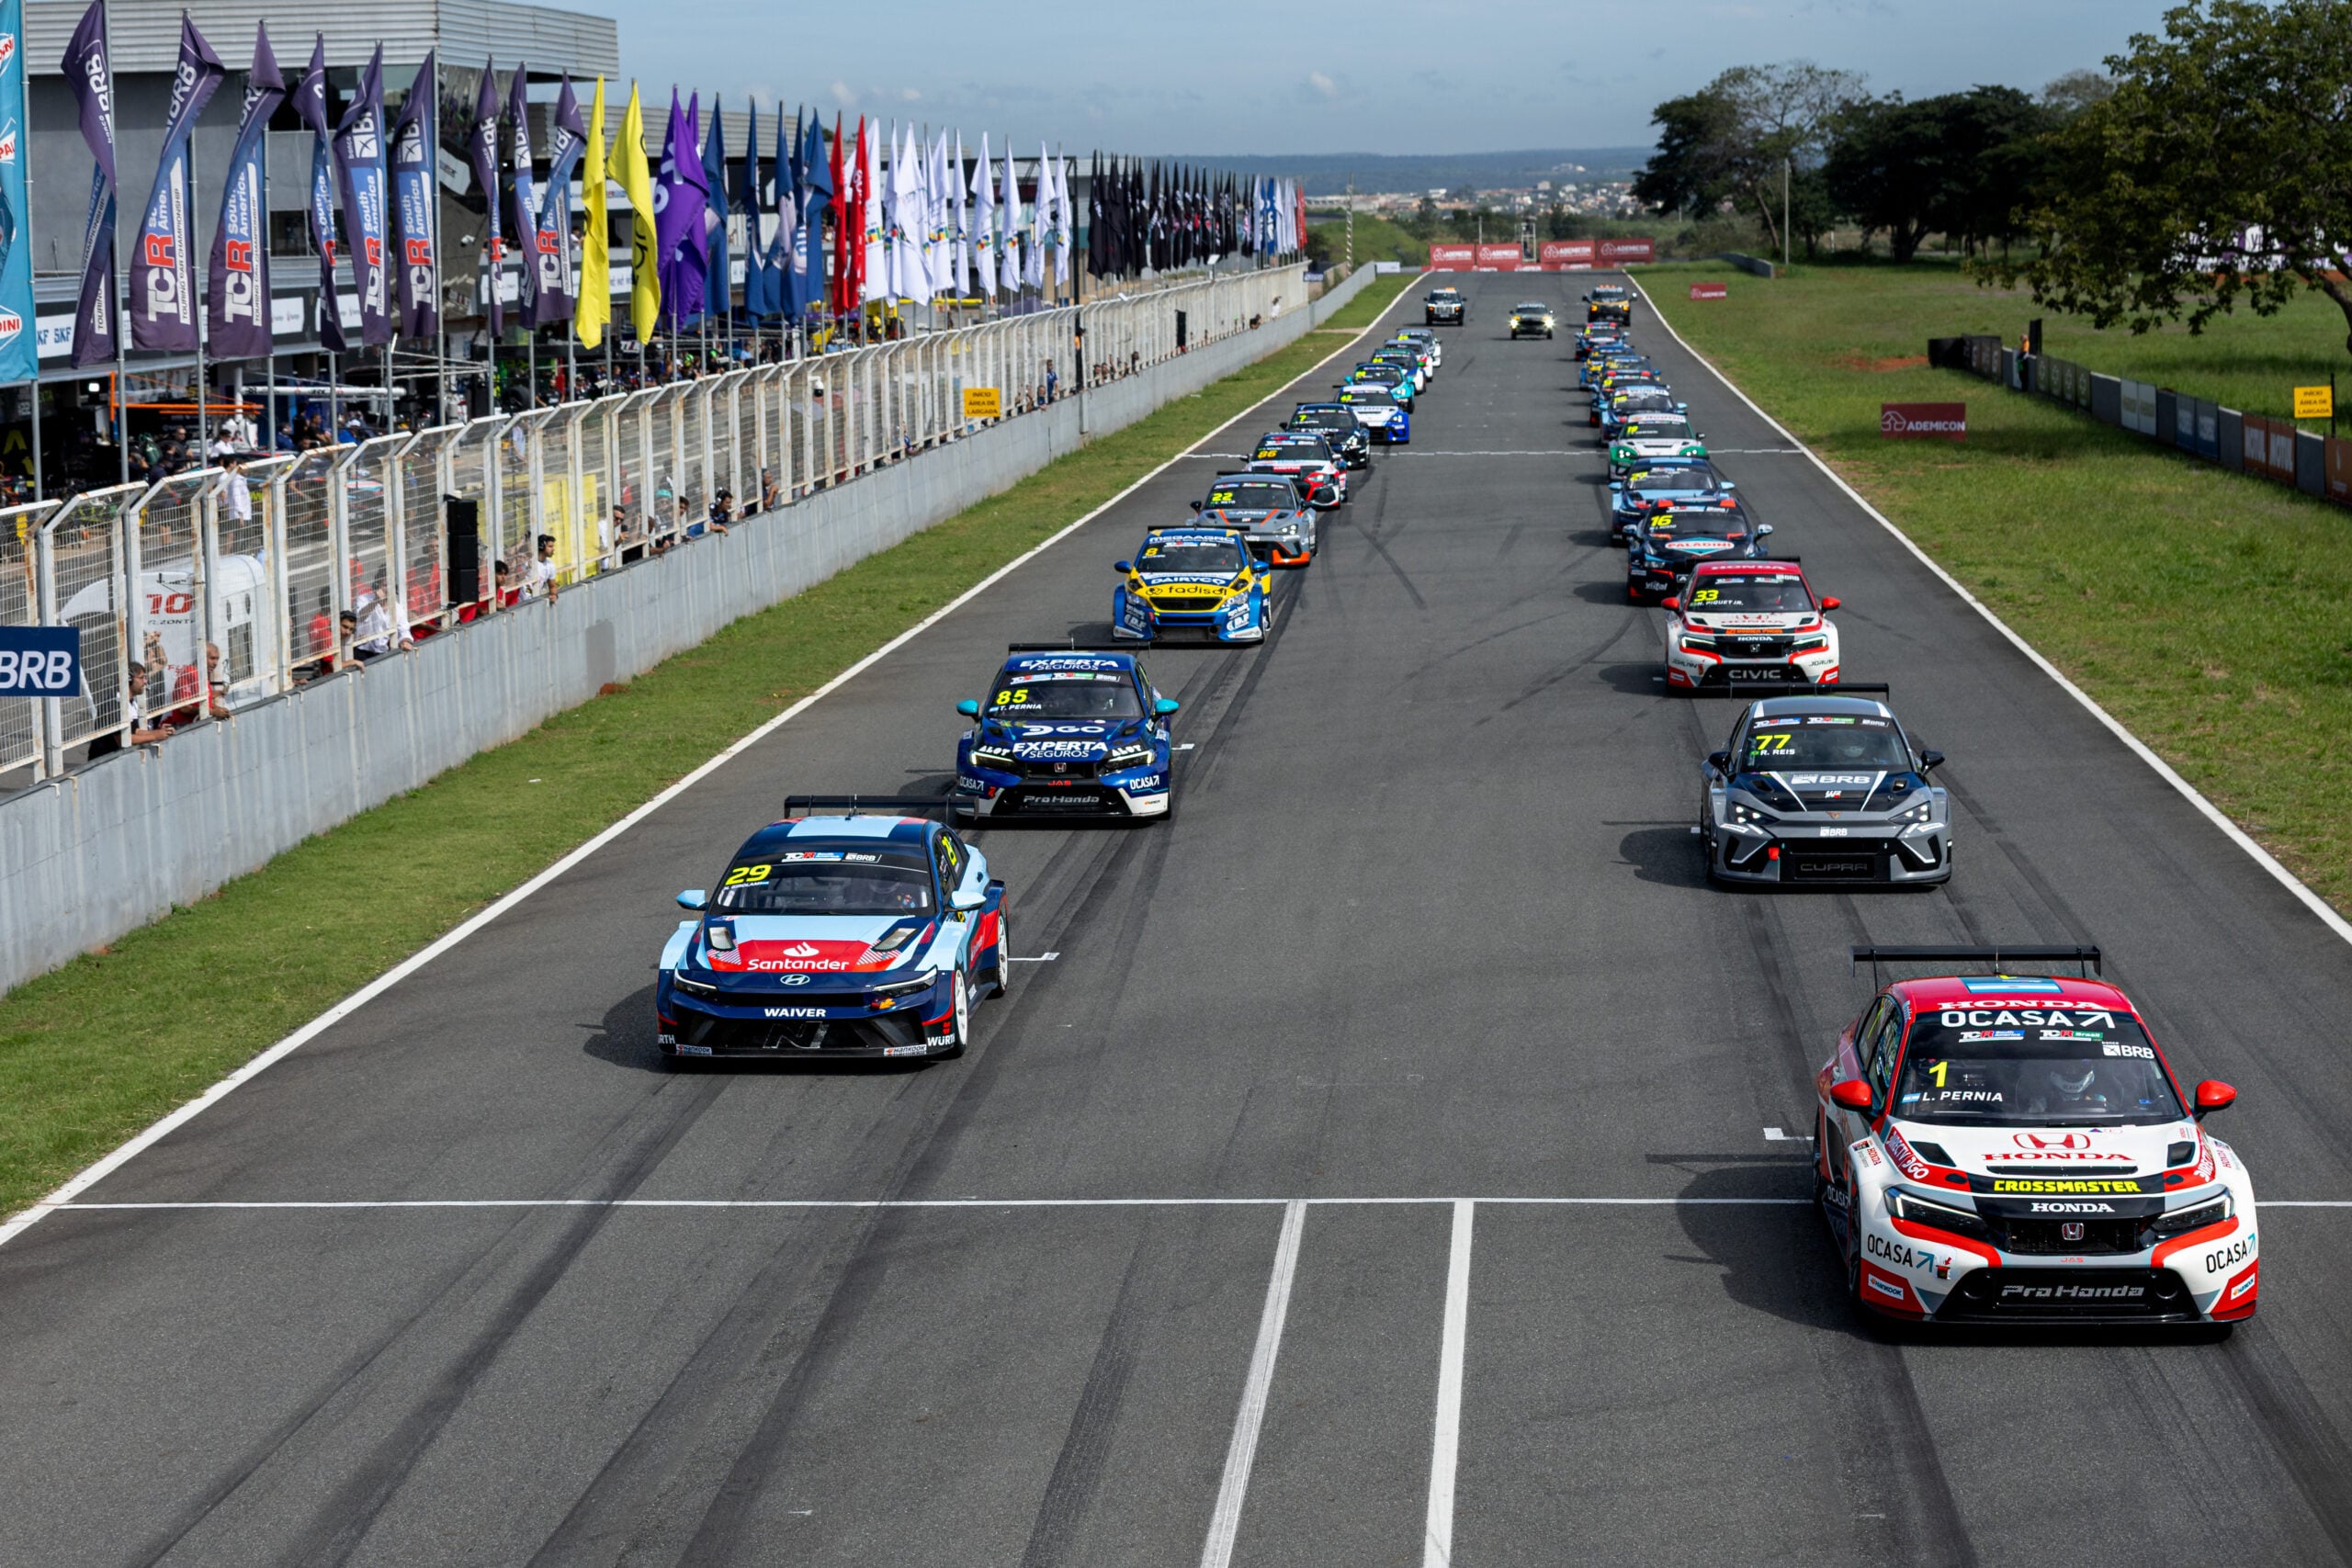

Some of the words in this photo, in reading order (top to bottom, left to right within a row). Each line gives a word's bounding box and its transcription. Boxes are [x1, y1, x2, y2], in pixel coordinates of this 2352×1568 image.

[358, 191, 373, 233] South
[411, 178, 425, 236] America
[401, 195, 413, 234] South
[537, 229, 562, 294] TCR
[144, 231, 182, 321] TCR
[405, 237, 432, 310] TCR
[225, 238, 254, 324] TCR
[53, 327, 72, 344] SKF
[1906, 419, 1965, 432] ADEMICON
[1257, 449, 1278, 459] 86
[1211, 491, 1234, 502] 22
[1651, 514, 1673, 526] 16
[1694, 589, 1720, 603] 33
[146, 592, 193, 615] 10
[0, 650, 72, 689] BRB
[1019, 660, 1119, 671] EXPERTA
[1728, 670, 1781, 679] CIVIC
[996, 689, 1028, 705] 85
[1012, 741, 1109, 757] EXPERTA
[1756, 734, 1792, 750] 77
[1029, 750, 1090, 759] SEGUROS
[1129, 776, 1154, 790] OCASA
[1819, 775, 1871, 784] BRB
[725, 864, 772, 886] 29
[747, 958, 850, 971] Santander
[1938, 999, 2110, 1010] HONDA
[764, 1008, 826, 1018] WAIVER
[1941, 1010, 2075, 1028] OCASA
[1960, 1031, 1994, 1040] TCR
[2040, 1030, 2073, 1038] TCR
[2121, 1045, 2155, 1059] BRB
[1928, 1061, 1950, 1088] 1
[1923, 1091, 1935, 1101] L.
[1940, 1090, 2004, 1102] PERNIA
[1982, 1153, 2135, 1162] HONDA
[1994, 1179, 2142, 1193] CROSSMASTER
[2030, 1201, 2116, 1213] HONDA
[1867, 1234, 1914, 1268] OCASA
[2205, 1239, 2248, 1273] OCASA
